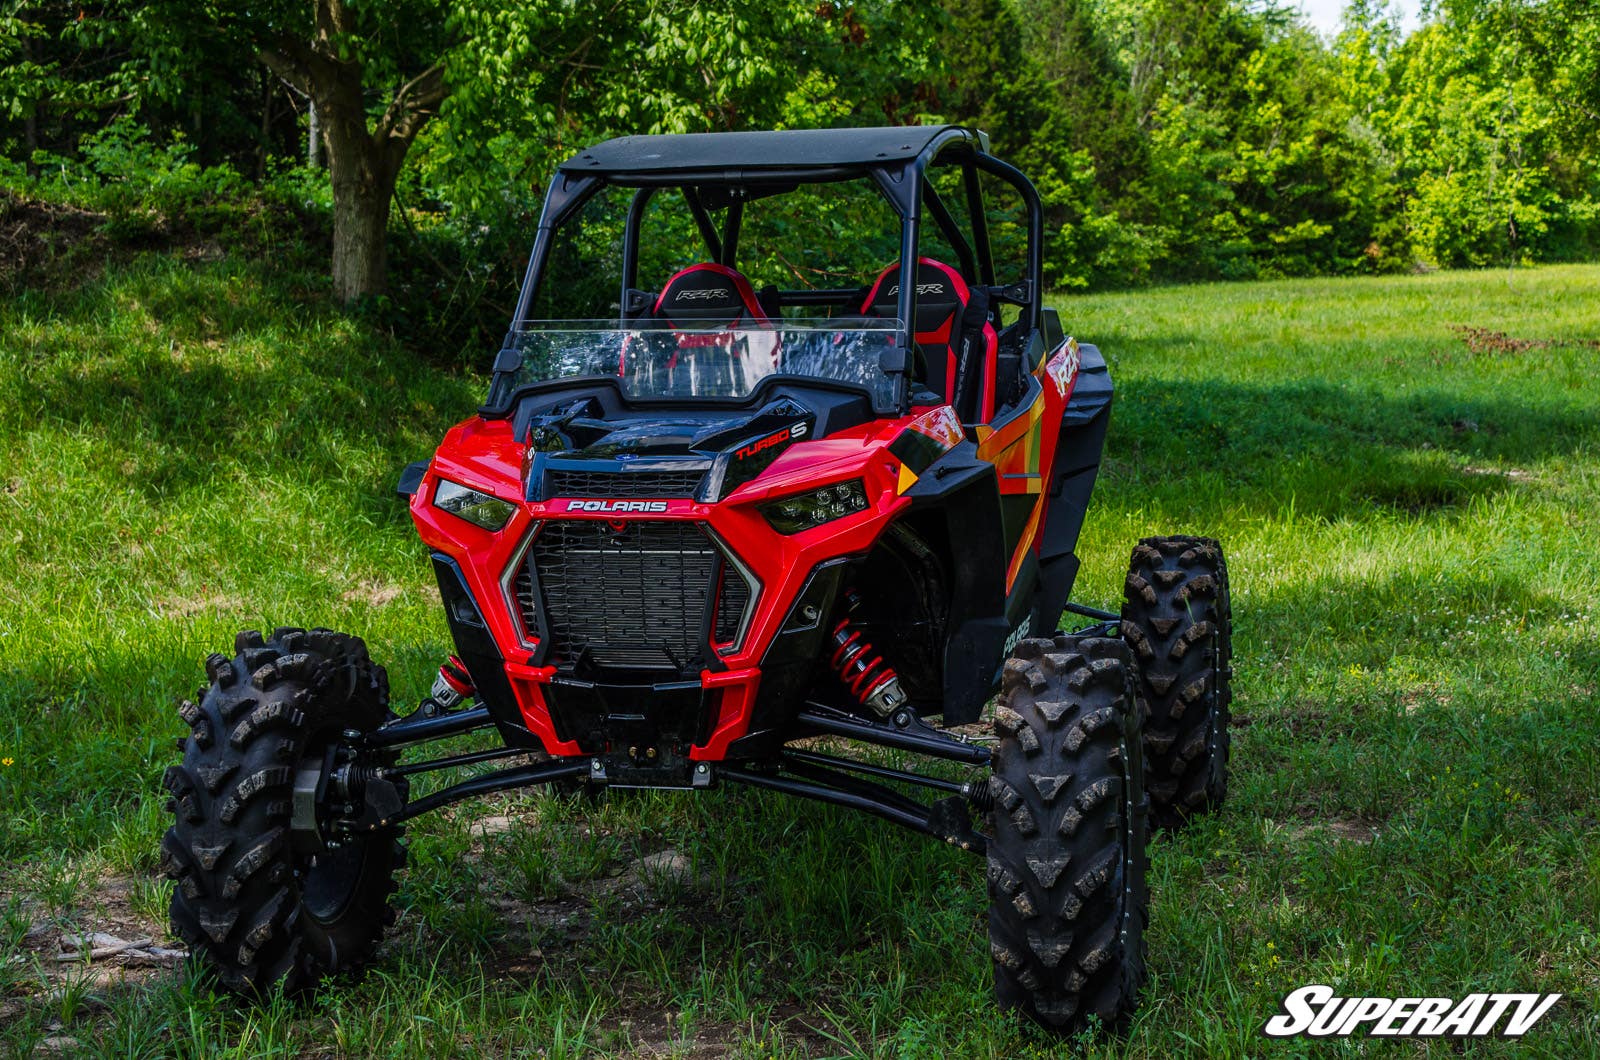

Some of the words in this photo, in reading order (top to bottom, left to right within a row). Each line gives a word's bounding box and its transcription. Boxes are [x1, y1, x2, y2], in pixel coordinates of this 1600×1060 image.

[675, 288, 729, 301] RZR
[735, 428, 790, 461] TURBO
[790, 421, 808, 439] S
[566, 500, 669, 513] POLARIS
